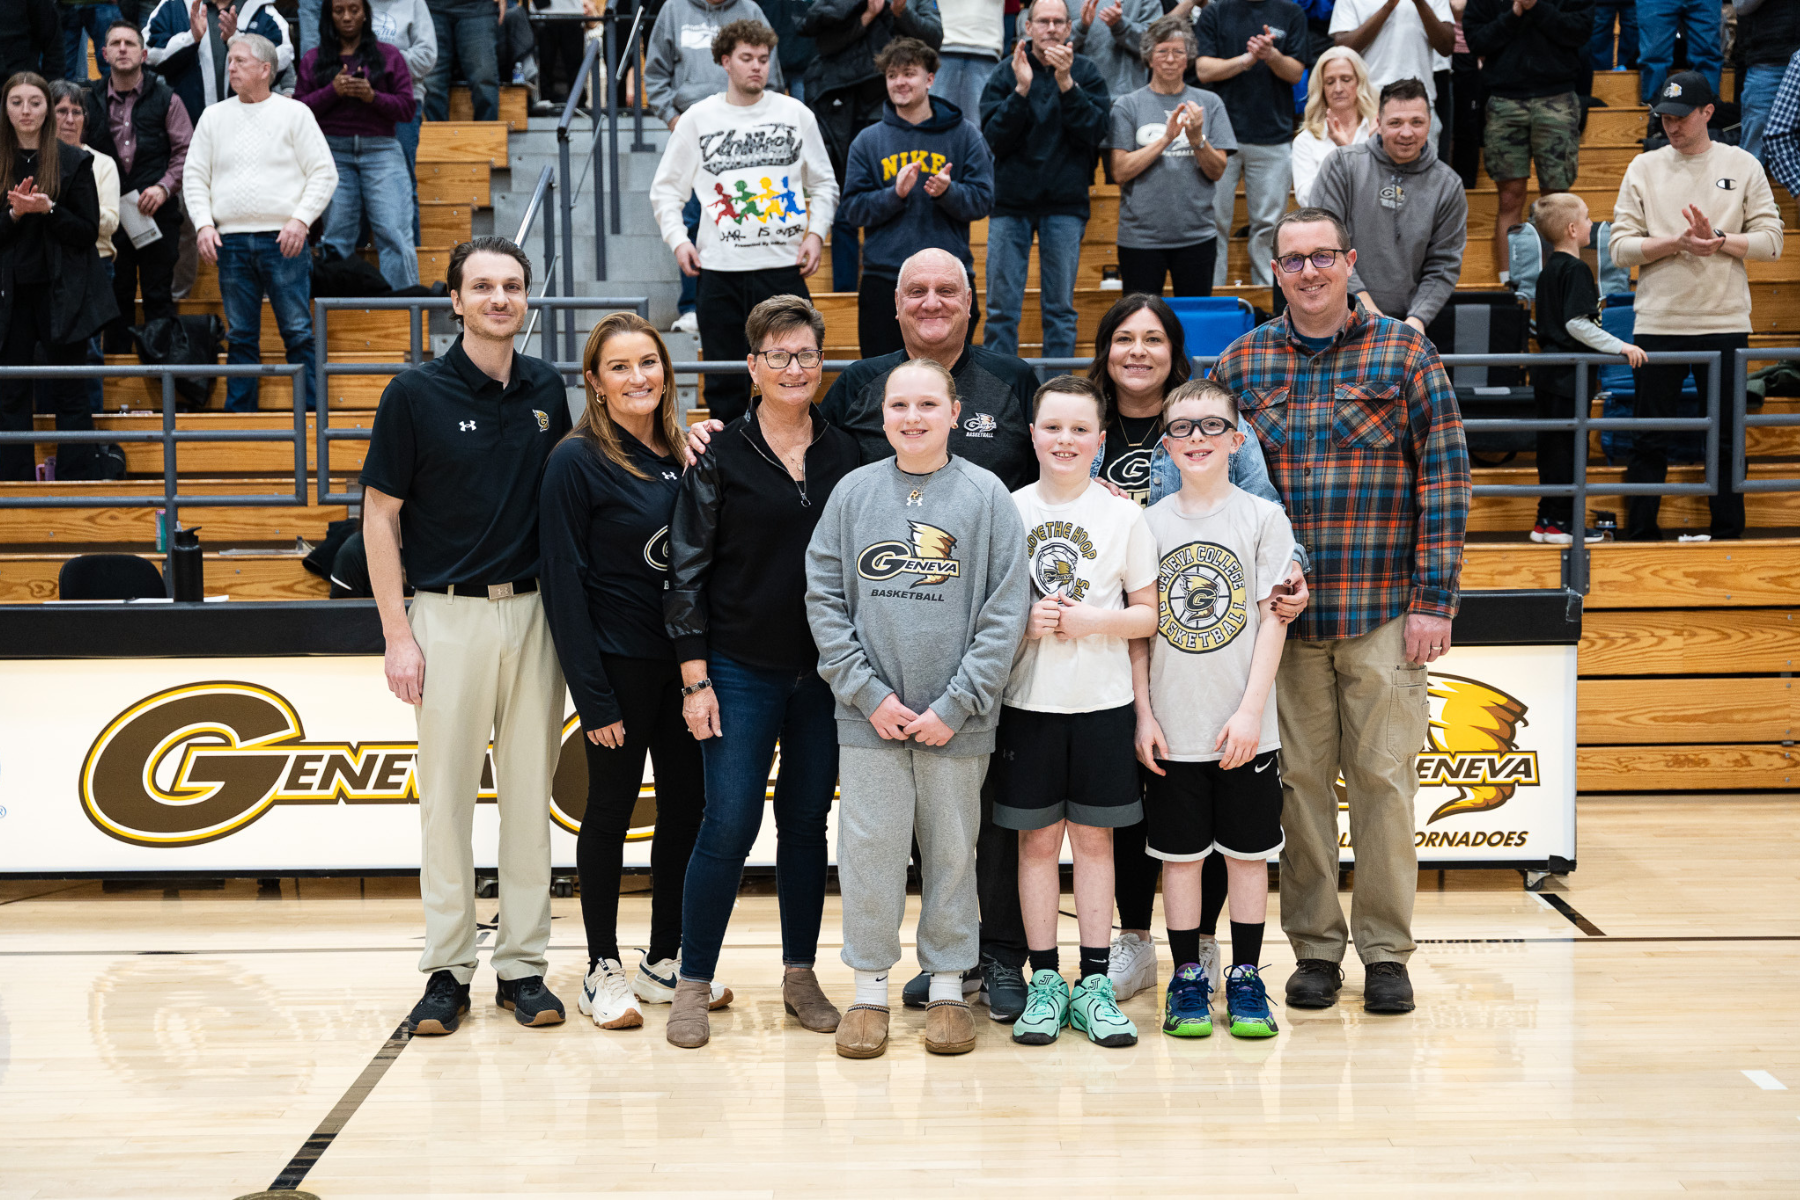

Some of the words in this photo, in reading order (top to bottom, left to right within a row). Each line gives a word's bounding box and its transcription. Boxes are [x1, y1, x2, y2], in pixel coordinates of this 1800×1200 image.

[881, 150, 946, 181] NIKE
[758, 227, 770, 237] IS
[776, 225, 804, 237] OVER
[1045, 521, 1074, 540] THE
[857, 540, 960, 581] GENEVA
[1157, 548, 1194, 593] GENEVA
[1196, 545, 1245, 590] COLLEGE
[870, 588, 945, 602] BASKETBALL
[1158, 600, 1247, 649] BASKETBALL
[79, 681, 497, 848] GENE
[1414, 830, 1529, 848] ORNADOES
